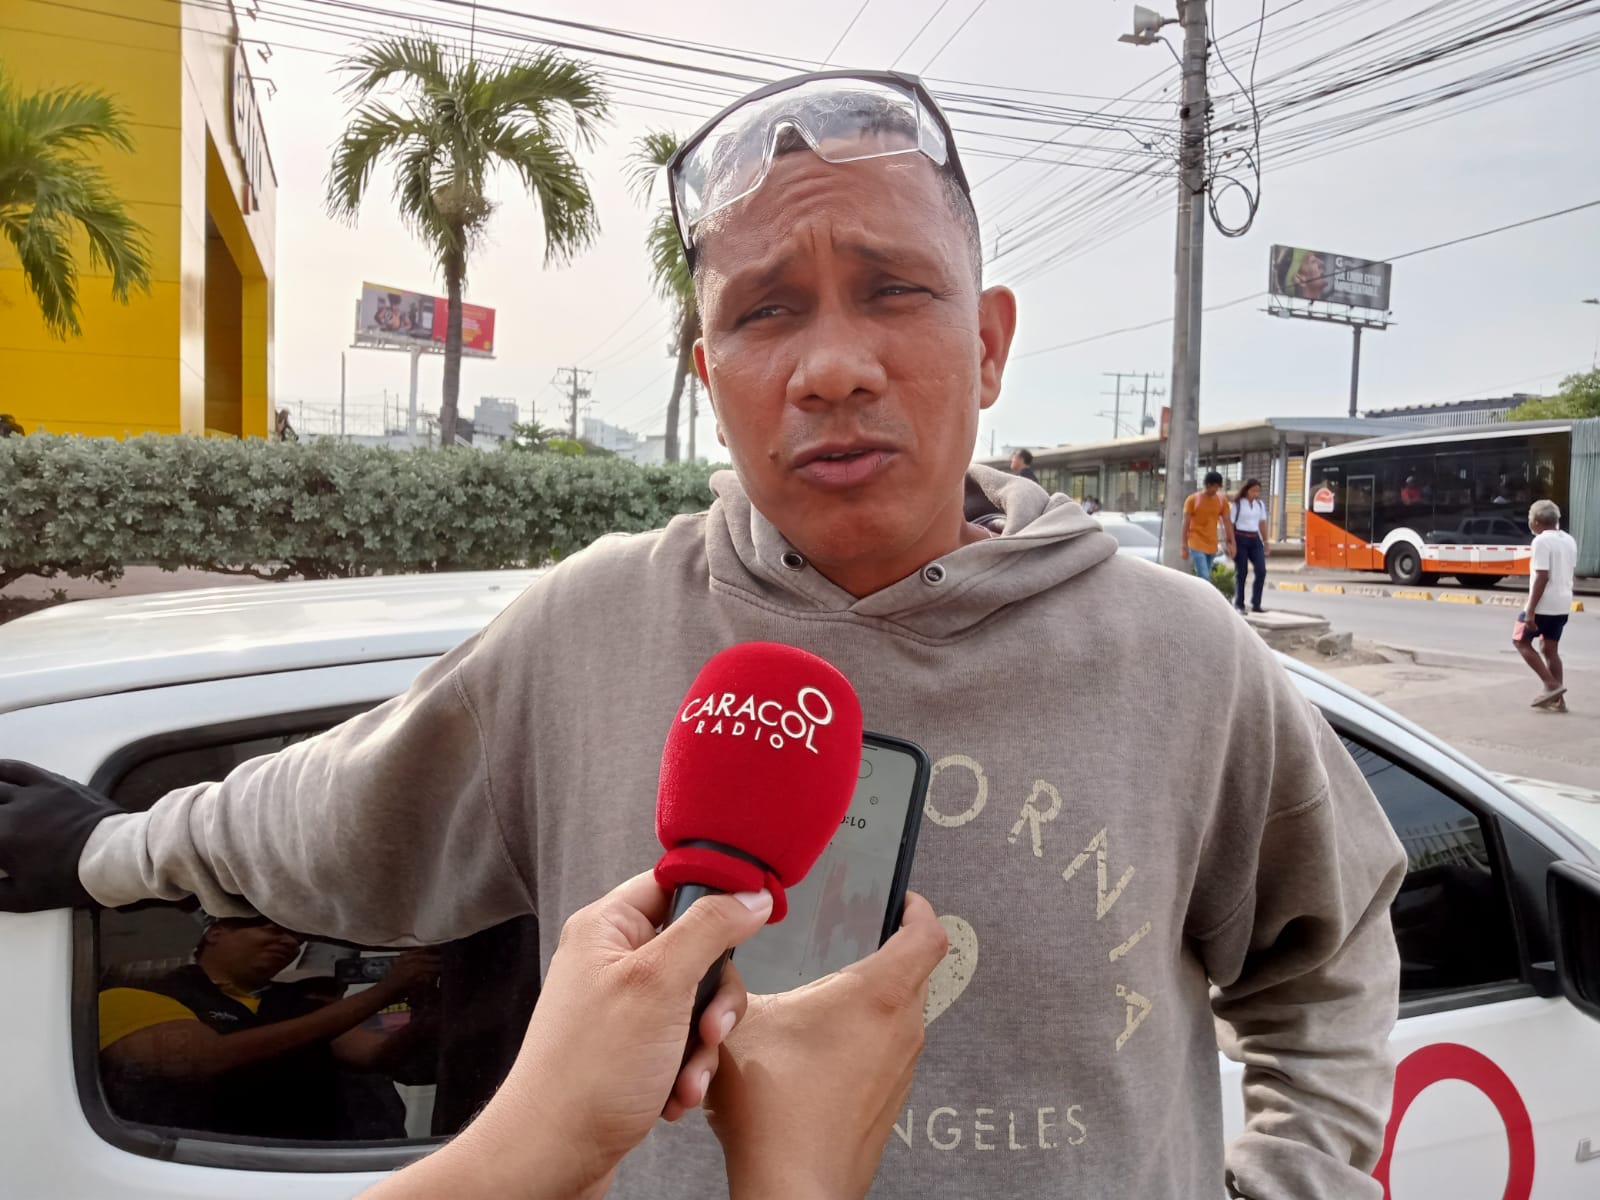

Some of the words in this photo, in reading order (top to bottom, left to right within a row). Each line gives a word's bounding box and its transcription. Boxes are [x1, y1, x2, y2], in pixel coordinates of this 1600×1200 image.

[694, 720, 785, 749] RADIO
[923, 754, 1152, 1050] ORNIA
[892, 1104, 1087, 1151] NGELES
